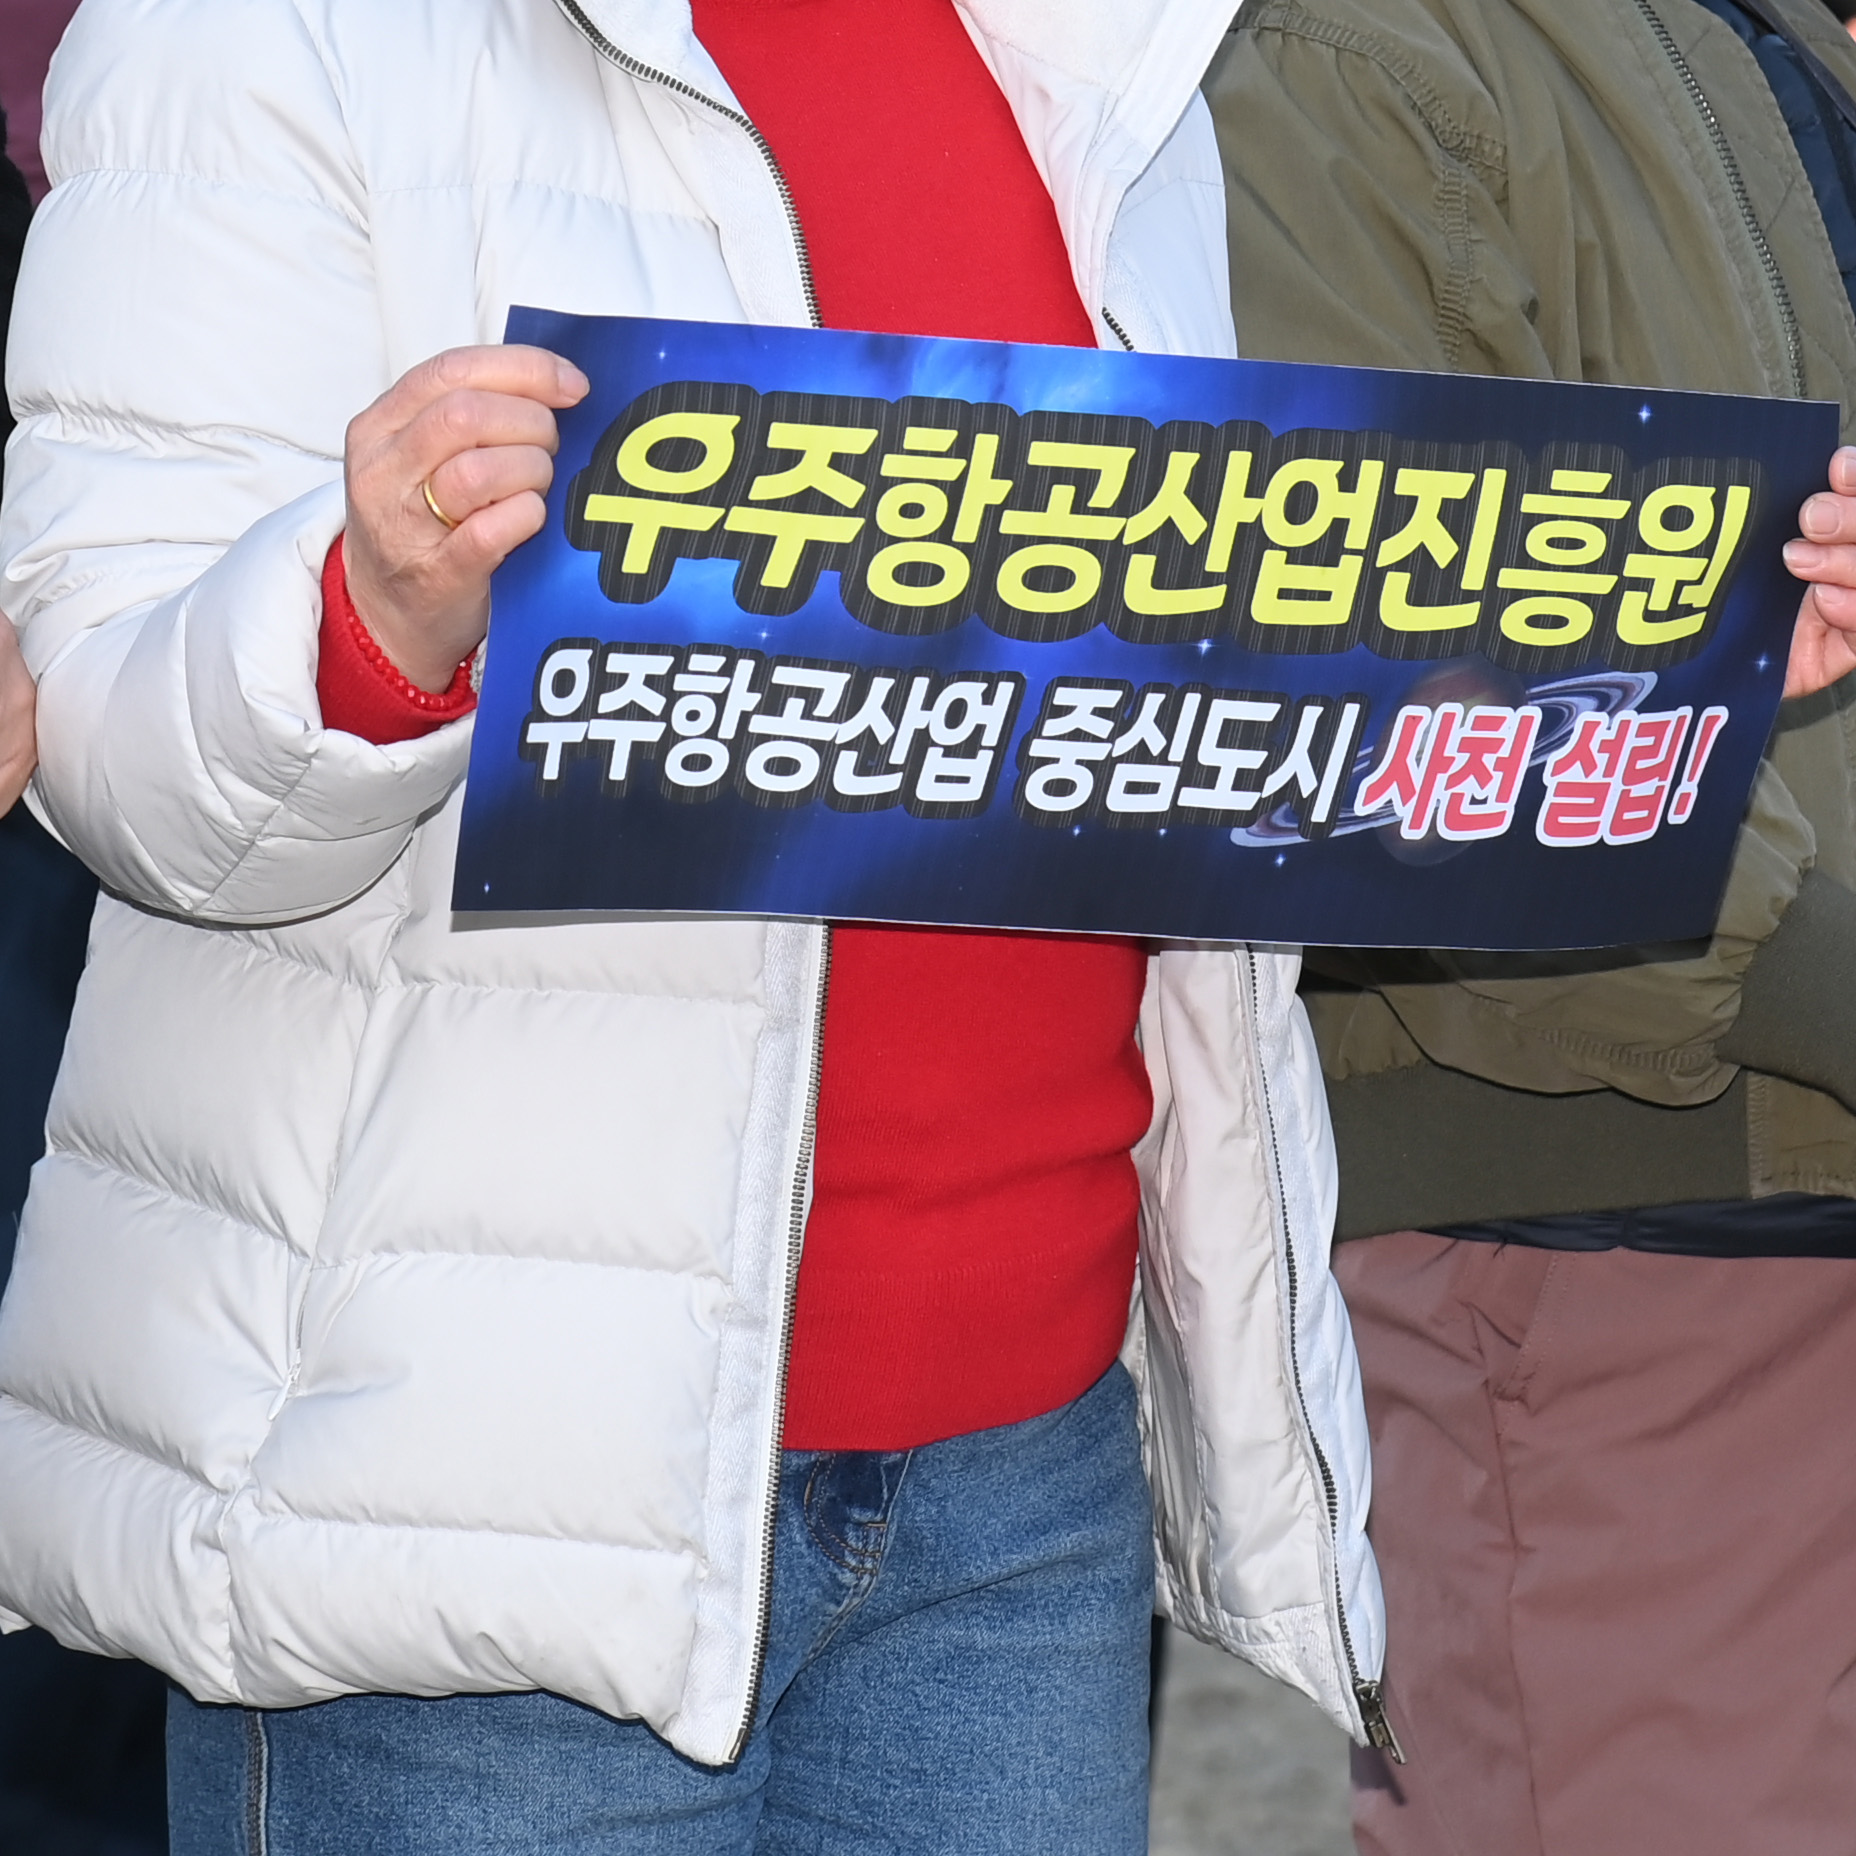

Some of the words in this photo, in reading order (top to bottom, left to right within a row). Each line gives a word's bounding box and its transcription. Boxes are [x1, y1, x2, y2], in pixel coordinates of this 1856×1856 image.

[584, 412, 1752, 646] 우주항공산업진흥원
[526, 648, 1010, 802] 우주항공산업
[1025, 687, 1357, 823] 중심도시
[1357, 707, 1535, 836] 사천
[1540, 708, 1724, 842] 설립!
